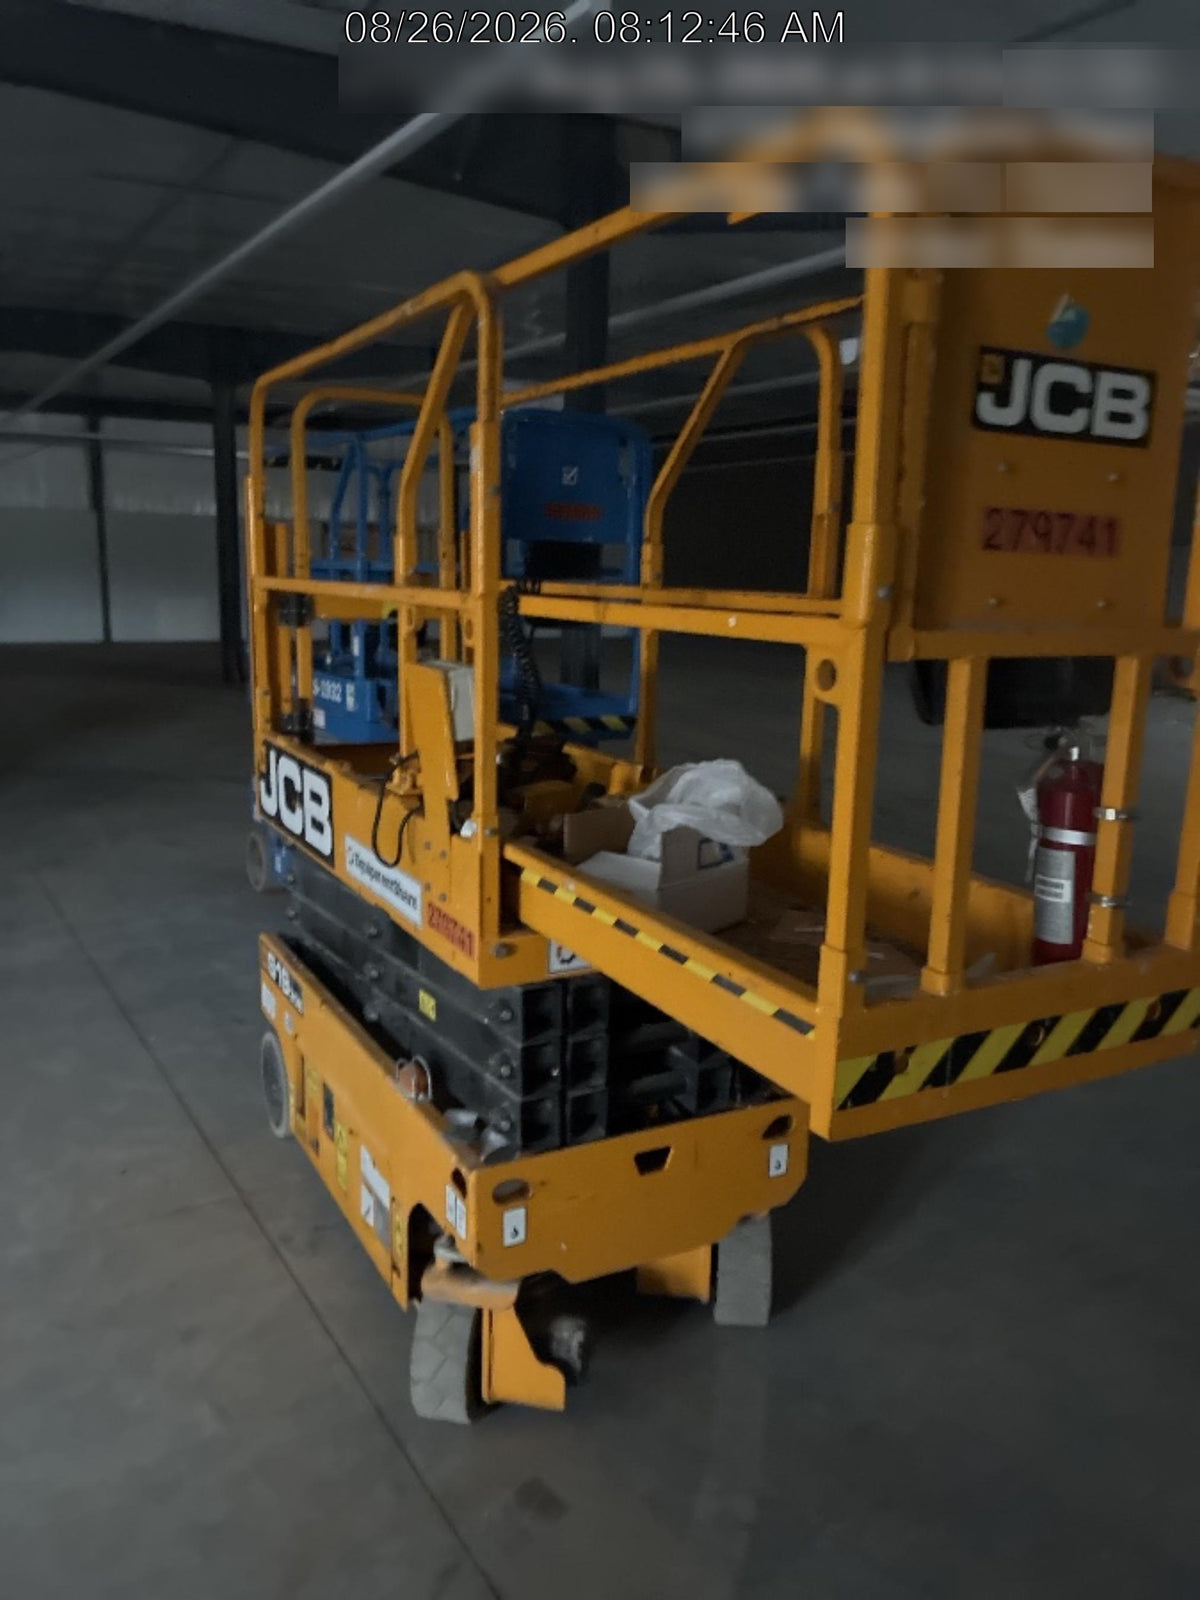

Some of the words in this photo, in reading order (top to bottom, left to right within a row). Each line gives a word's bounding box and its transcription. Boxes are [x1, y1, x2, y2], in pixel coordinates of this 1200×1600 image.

[976, 359, 1150, 440] JCB
[982, 507, 1118, 556] 279741
[260, 748, 332, 855] JCB
